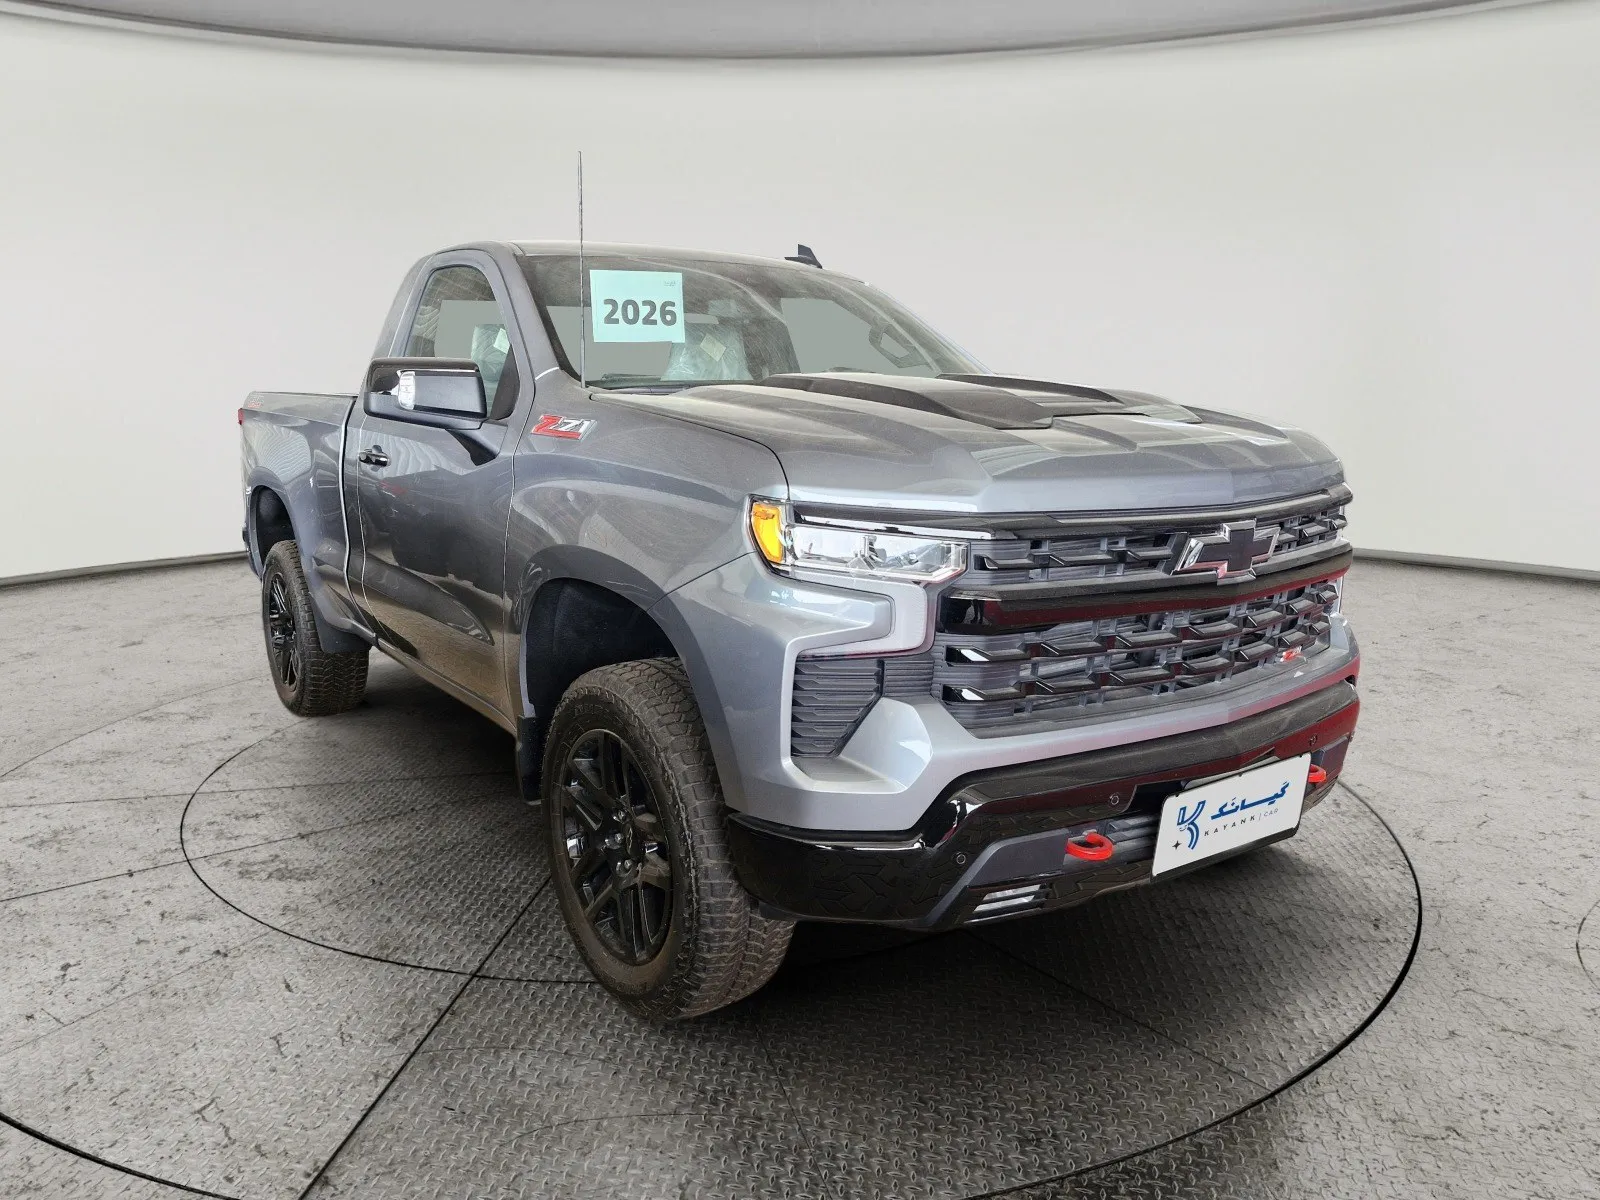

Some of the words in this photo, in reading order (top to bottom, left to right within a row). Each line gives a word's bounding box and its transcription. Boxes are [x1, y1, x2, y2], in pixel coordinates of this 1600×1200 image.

[603, 298, 677, 326] 2026
[530, 414, 597, 441] Z71
[1203, 814, 1256, 837] KAYANK
